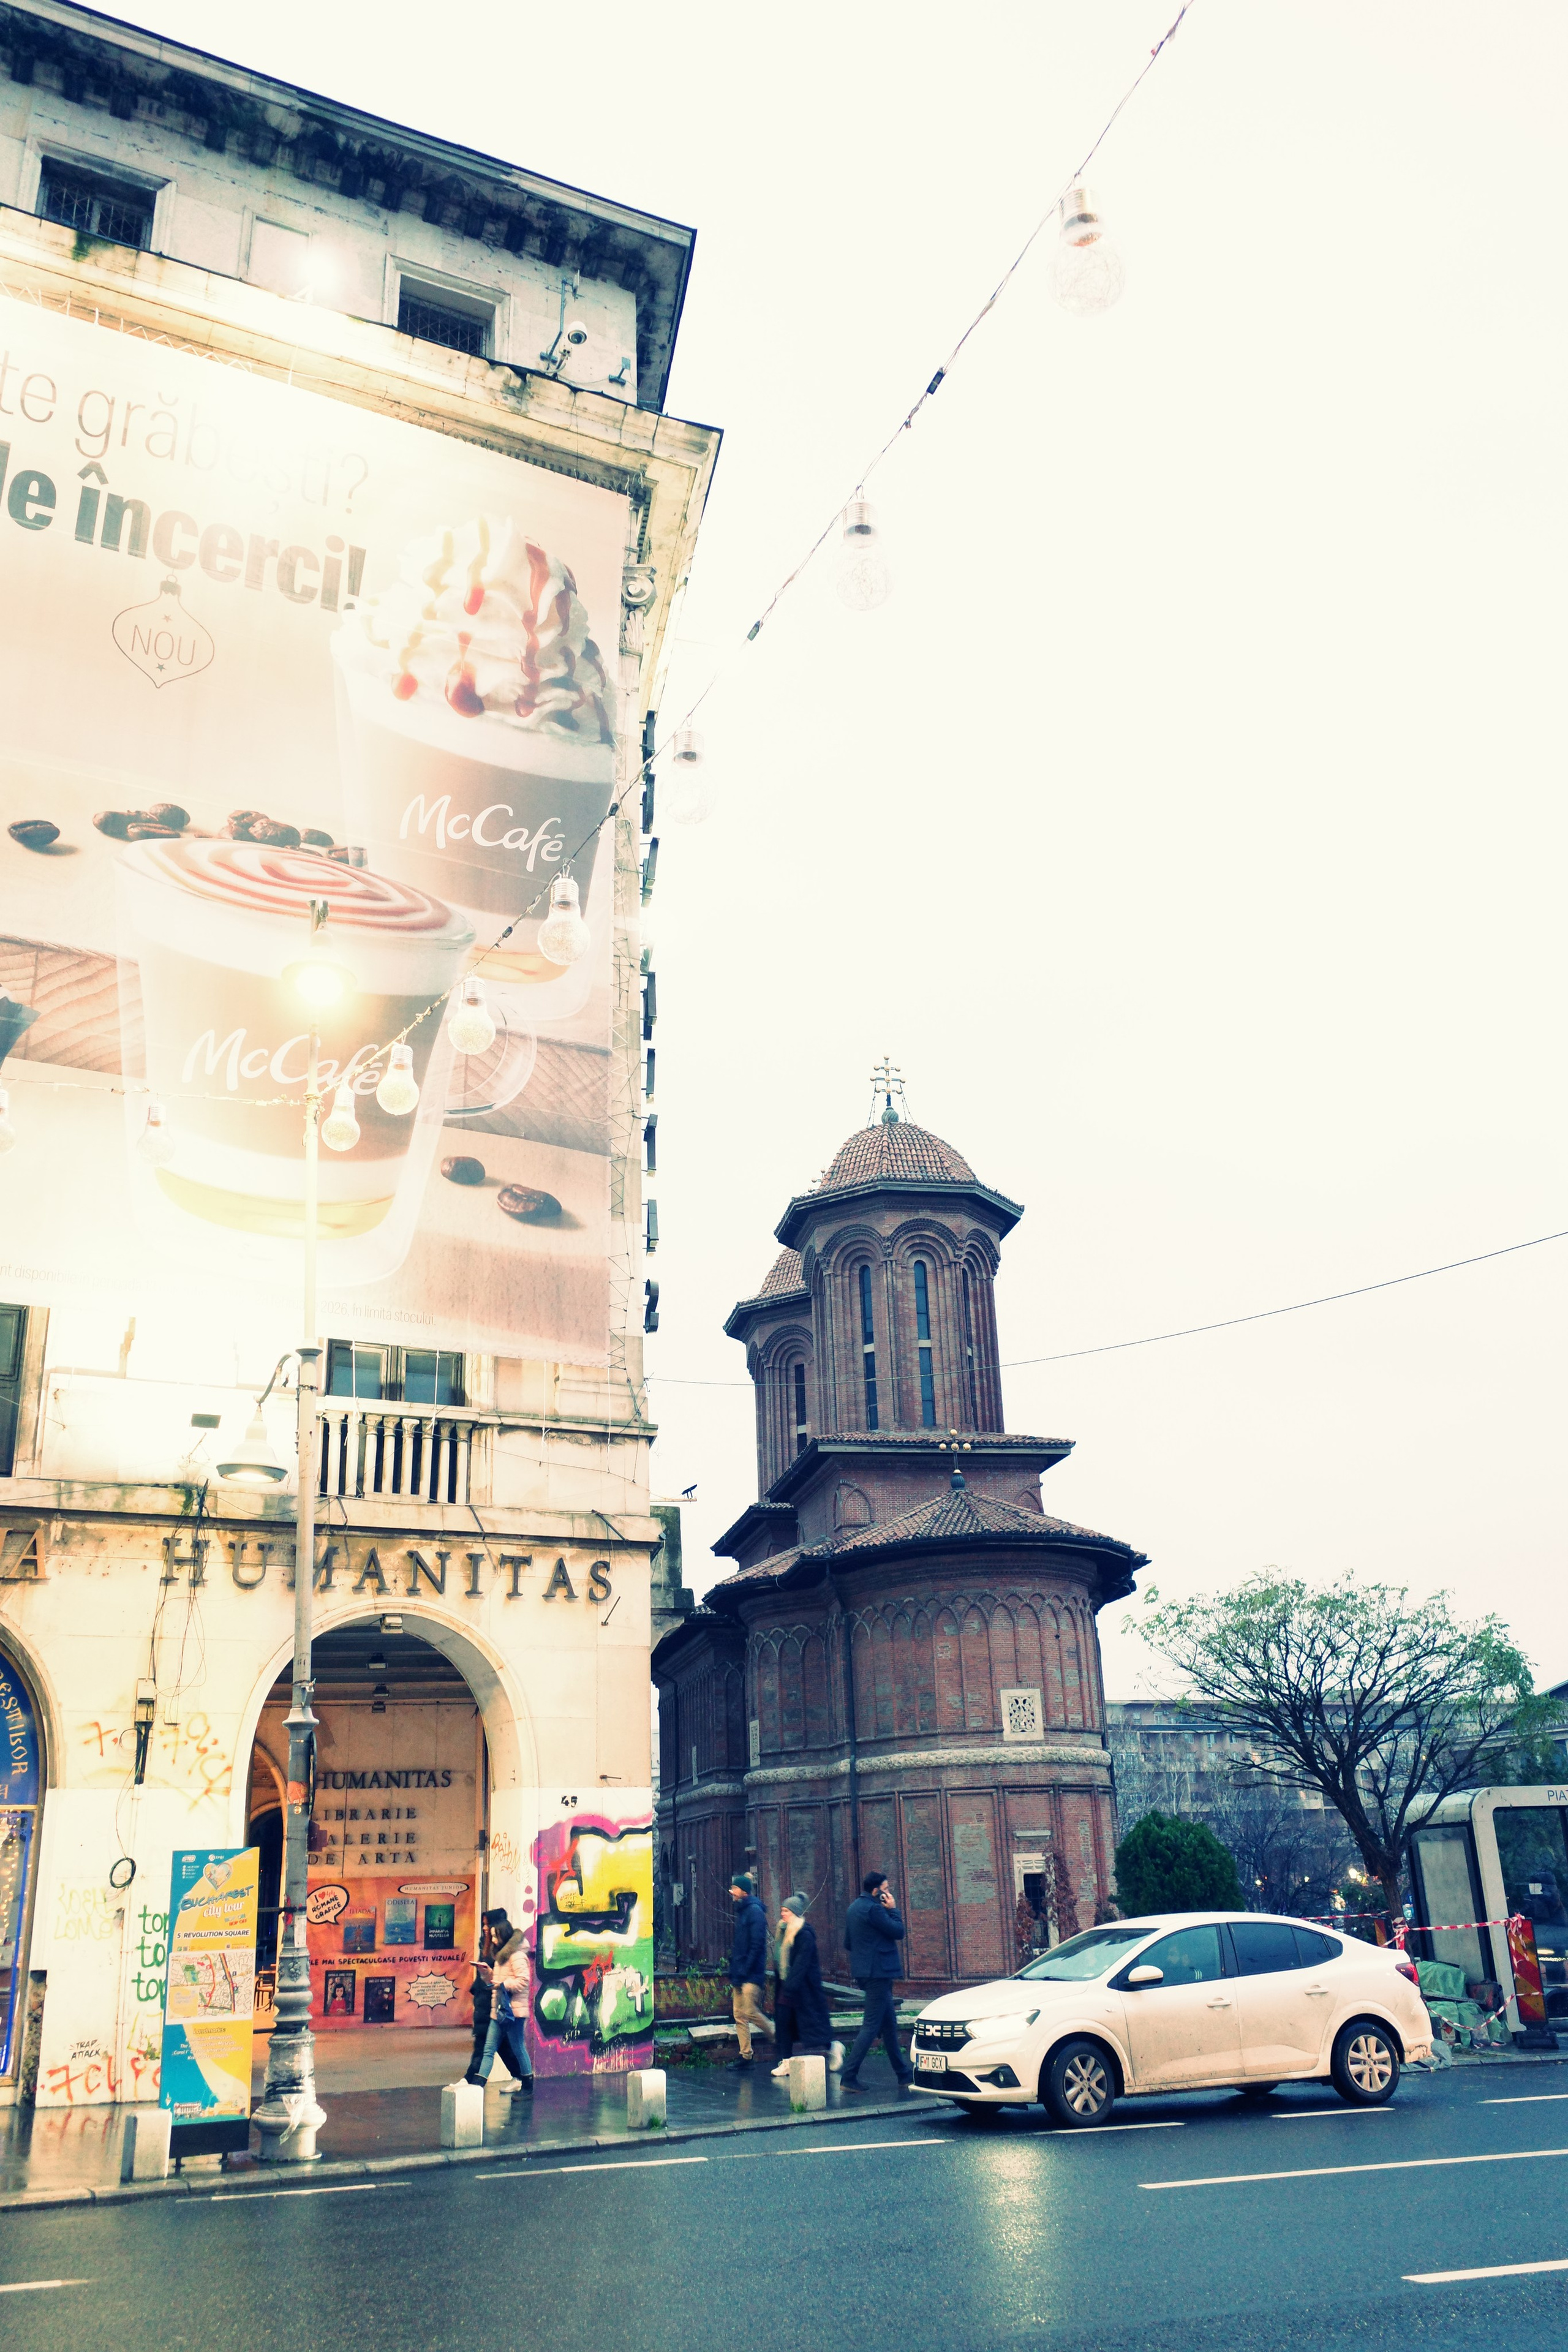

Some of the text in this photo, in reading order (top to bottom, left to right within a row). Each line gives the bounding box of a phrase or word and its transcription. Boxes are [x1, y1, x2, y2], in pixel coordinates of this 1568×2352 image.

[74, 461, 367, 613] încerci!
[130, 624, 196, 666] NOU
[320, 1300, 350, 1317] 2026,
[353, 1303, 361, 1317] în
[364, 1303, 392, 1321] limita
[394, 1310, 437, 1326] stocului.
[159, 1536, 612, 1602] HUMANITAS
[315, 1770, 452, 1789] HUMANITAS
[561, 1795, 578, 1807] 45
[328, 1832, 416, 1845] ALERIE
[307, 1851, 417, 1866] DE ARTA
[180, 1885, 254, 1911] BUCHAREST
[312, 1894, 339, 1913] ROMANE
[314, 1894, 319, 1903] I
[203, 1902, 244, 1918] city tour
[315, 1902, 342, 1920] GRAFICE
[399, 1956, 428, 1964] POVEȘTI
[431, 1951, 466, 1962] VIZUALE!
[76, 2039, 98, 2049] TRAP
[70, 2048, 101, 2060] ATTACK
[932, 2057, 943, 2070] GCX
